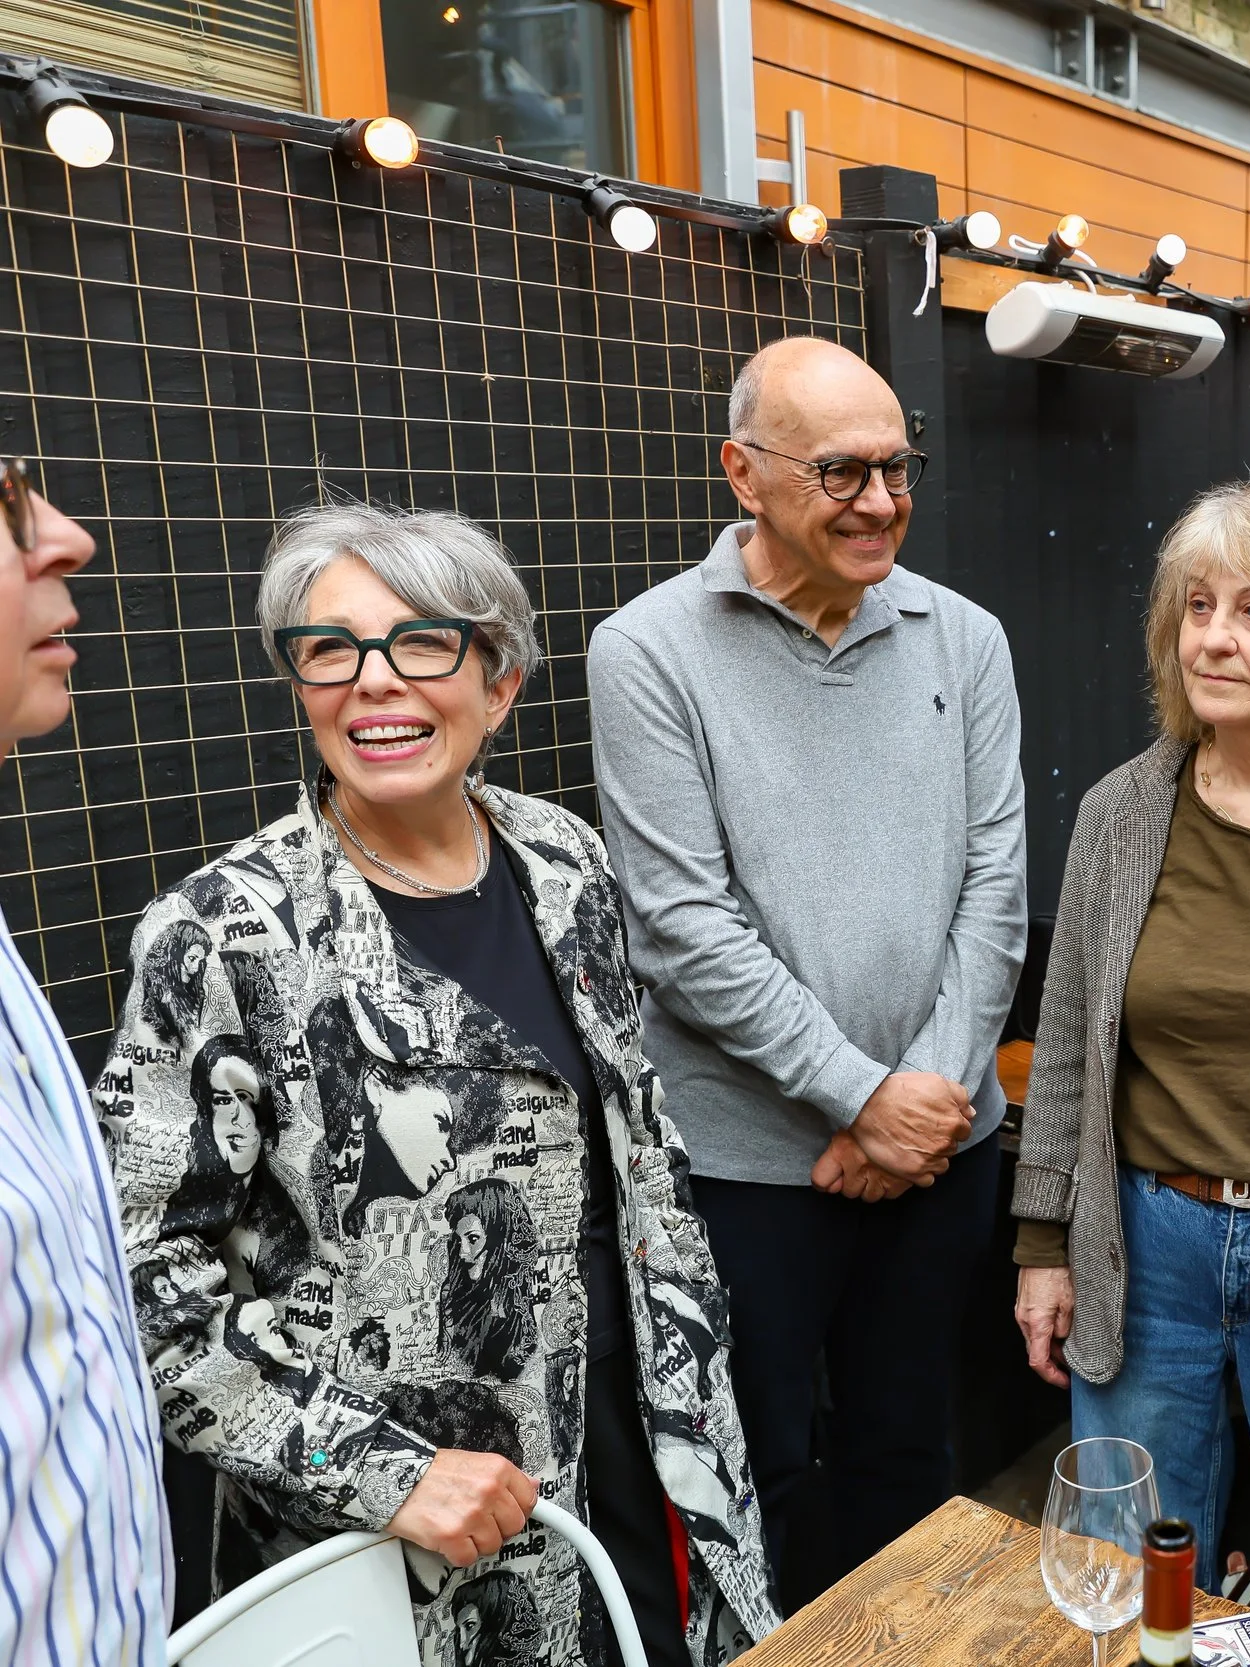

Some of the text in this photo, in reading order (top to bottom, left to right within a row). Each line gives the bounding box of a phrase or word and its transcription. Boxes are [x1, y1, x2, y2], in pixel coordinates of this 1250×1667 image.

[502, 1116, 537, 1145] and
[493, 1145, 539, 1170] made
[302, 1278, 334, 1306] and
[285, 1304, 334, 1332] made
[498, 1532, 547, 1562] made
